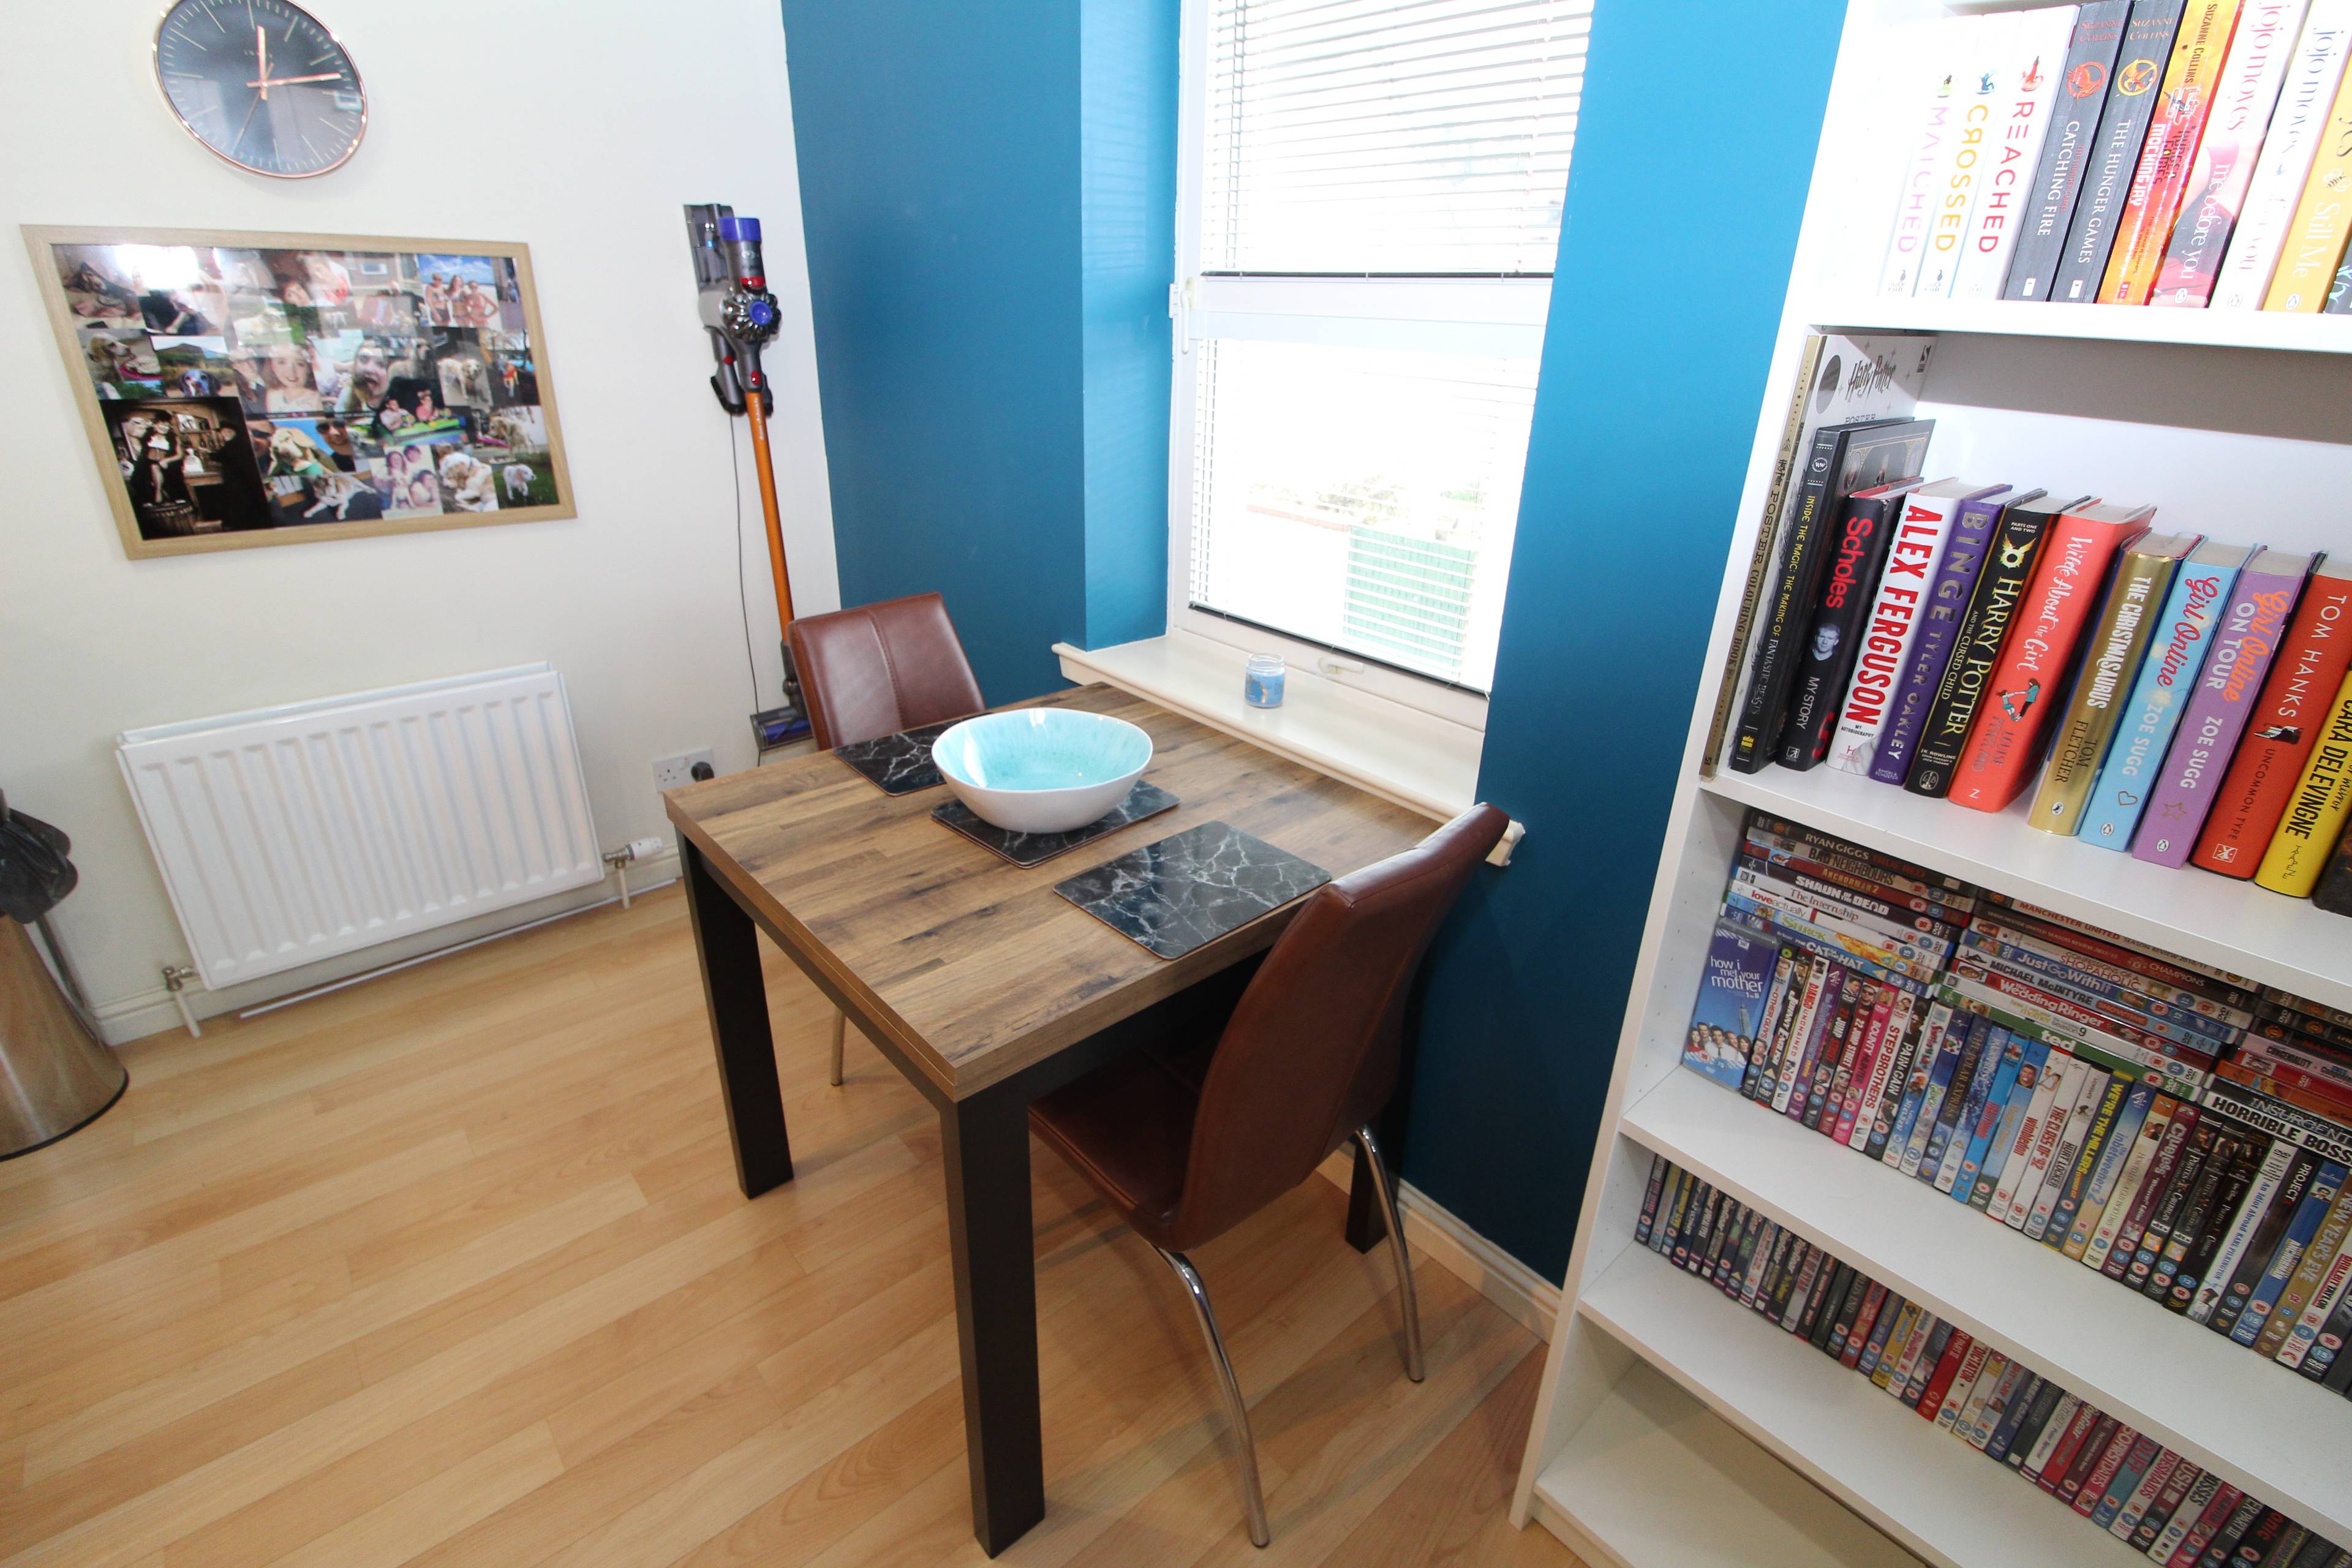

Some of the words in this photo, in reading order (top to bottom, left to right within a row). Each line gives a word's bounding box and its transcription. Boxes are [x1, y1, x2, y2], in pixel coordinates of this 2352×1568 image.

[2195, 4, 2218, 45] SUZANNE
[2250, 2, 2291, 49] jojo
[2185, 47, 2204, 83] COLLINS
[2305, 28, 2344, 74] jojo
[2227, 55, 2267, 130] moyes
[2111, 119, 2131, 148] THE
[1935, 104, 1989, 251] CROSSED
[1978, 101, 2035, 253] REACHED
[2047, 121, 2079, 200] CATCHING
[2128, 123, 2166, 206] MOCKINGJAY
[2209, 164, 2231, 191] me
[2092, 153, 2121, 214] HUNGER
[2037, 206, 2057, 236] FIRE
[2191, 195, 2222, 246] before
[2305, 202, 2342, 240] Still
[2078, 217, 2101, 264] GAMES
[2180, 249, 2202, 279] you
[2293, 247, 2326, 279] Me
[1845, 361, 1872, 402] Harry
[1867, 355, 1896, 395] Potter
[1802, 496, 1815, 522] INSIDE
[1754, 491, 1779, 565] POSTER
[1796, 524, 1808, 541] THE
[1889, 505, 1943, 579] ALEX
[1789, 544, 1803, 573] MAGIC:
[1825, 516, 1873, 609] Scholes
[1930, 512, 1989, 623] BINGE
[2054, 536, 2092, 577] Wilde
[1784, 575, 1795, 591] THE
[2130, 576, 2152, 600] THE
[2185, 575, 2221, 619] Girl
[1738, 569, 1759, 633] COLOURING
[1776, 593, 1791, 624] MAKING
[1973, 576, 2024, 654] HARRY
[2040, 576, 2074, 630] About
[2229, 601, 2255, 633] ON
[2253, 590, 2290, 637] Girl
[2310, 594, 2347, 640] TOM
[1773, 624, 1782, 637] OF
[1728, 634, 1743, 667] BOOK
[1760, 639, 1779, 686] FANTASTIC
[1845, 586, 1919, 725] FERGUSON
[1912, 631, 1943, 685] TYLER
[1954, 635, 1972, 669] CURSED
[2016, 637, 2049, 671] Girl
[2086, 601, 2143, 709] CHRISTMASAURUS
[2156, 621, 2201, 687] Online
[2206, 639, 2236, 691] TOUR
[1806, 676, 1820, 694] MY
[1941, 670, 1958, 701] CHILD
[2222, 638, 2267, 703] Online
[2278, 649, 2323, 718] HANKS
[1751, 684, 1767, 715] BEASTS
[1796, 694, 1815, 729] STORY
[1940, 656, 1994, 736] POTTER
[1841, 726, 1874, 738] AUTOBIOGRAPHY
[1888, 693, 1921, 760] OAKLEY
[2143, 703, 2167, 730] ZOE
[2196, 715, 2223, 748] ZOE
[2328, 700, 2352, 742] CARA
[1929, 750, 1956, 760] ROWLING
[1972, 715, 2005, 773] PENTLAND
[1996, 730, 2015, 766] LOUISE
[2054, 720, 2089, 783] FLETCHER
[2076, 739, 2098, 767] TOM
[2120, 731, 2151, 778] SUGG
[2179, 750, 2208, 790] SUGG
[2239, 748, 2277, 813] UNCOMMON
[2285, 745, 2348, 840] DELEVINGNE
[2227, 817, 2248, 840] TYPE
[1805, 833, 1834, 850] RYAN
[1835, 842, 1869, 860] GIGGS
[1831, 854, 1896, 885] NEIGHBOURS
[1751, 891, 1773, 904] love
[1772, 898, 1808, 917] actually
[1790, 888, 1809, 902] The
[1810, 897, 1859, 922] Internship
[1795, 876, 1840, 900] SHAUN
[1852, 895, 1889, 915] DEAD
[2019, 901, 2082, 929] MANCHESTER
[2084, 923, 2119, 940] UNITED
[1710, 956, 1733, 969] how
[1806, 941, 1830, 957] CAT
[1838, 954, 1864, 970] HAT
[2018, 951, 2048, 971] Just
[2059, 954, 2143, 990] SHOPAHOLIC
[1711, 976, 1763, 992] mother
[1721, 968, 1737, 978] met
[1741, 971, 1760, 981] your
[1990, 961, 2035, 984] MICHAEL
[2037, 976, 2093, 1005] McINTYRE
[2149, 962, 2206, 987] CHAMPIONS
[1767, 992, 1779, 1017] OTHER
[1782, 990, 1800, 1030] JOHNNY
[1804, 982, 1819, 1009] DJANGO
[1999, 979, 2057, 1010] Wedding
[2058, 1001, 2104, 1027] Ringer
[1760, 1016, 1772, 1039] GUYS
[1791, 1009, 1809, 1057] UNCHAINED
[1834, 1017, 1847, 1038] JUMP
[1855, 1018, 1865, 1029] 22
[1866, 1021, 1882, 1055] BOUNTY
[1885, 1025, 1901, 1055] STEP
[2078, 1027, 2087, 1037] 9
[1898, 1042, 1914, 1066] PAIN
[1865, 1054, 1891, 1109] BROTHERS
[1888, 1070, 1903, 1096] GAIN
[2099, 1083, 2124, 1115] WE'RE
[2052, 1106, 2068, 1121] THE
[2094, 1117, 2111, 1136] THE
[2211, 1096, 2301, 1141] HORRIBLE
[2013, 1116, 2038, 1156] wimbledon
[2042, 1120, 2062, 1146] CLASS
[2154, 1122, 2187, 1176] Clueless
[2062, 1140, 2078, 1162] HURT
[2079, 1134, 2103, 1174] MILLERS
[2095, 1132, 2124, 1196] inbetweeners
[2048, 1160, 2074, 1189] LOCKER
[2260, 1182, 2271, 1192] An
[2286, 1163, 2313, 1202] PROJECT
[2087, 1193, 2105, 1207] 2
[2251, 1193, 2266, 1208] Idiot
[2241, 1208, 2258, 1233] Abroad
[2233, 1232, 2247, 1247] KARL
[2214, 1247, 2236, 1280] PILKINGTON
[2298, 1257, 2323, 1283] EVE
[1959, 1345, 1983, 1383] DICTATOR
